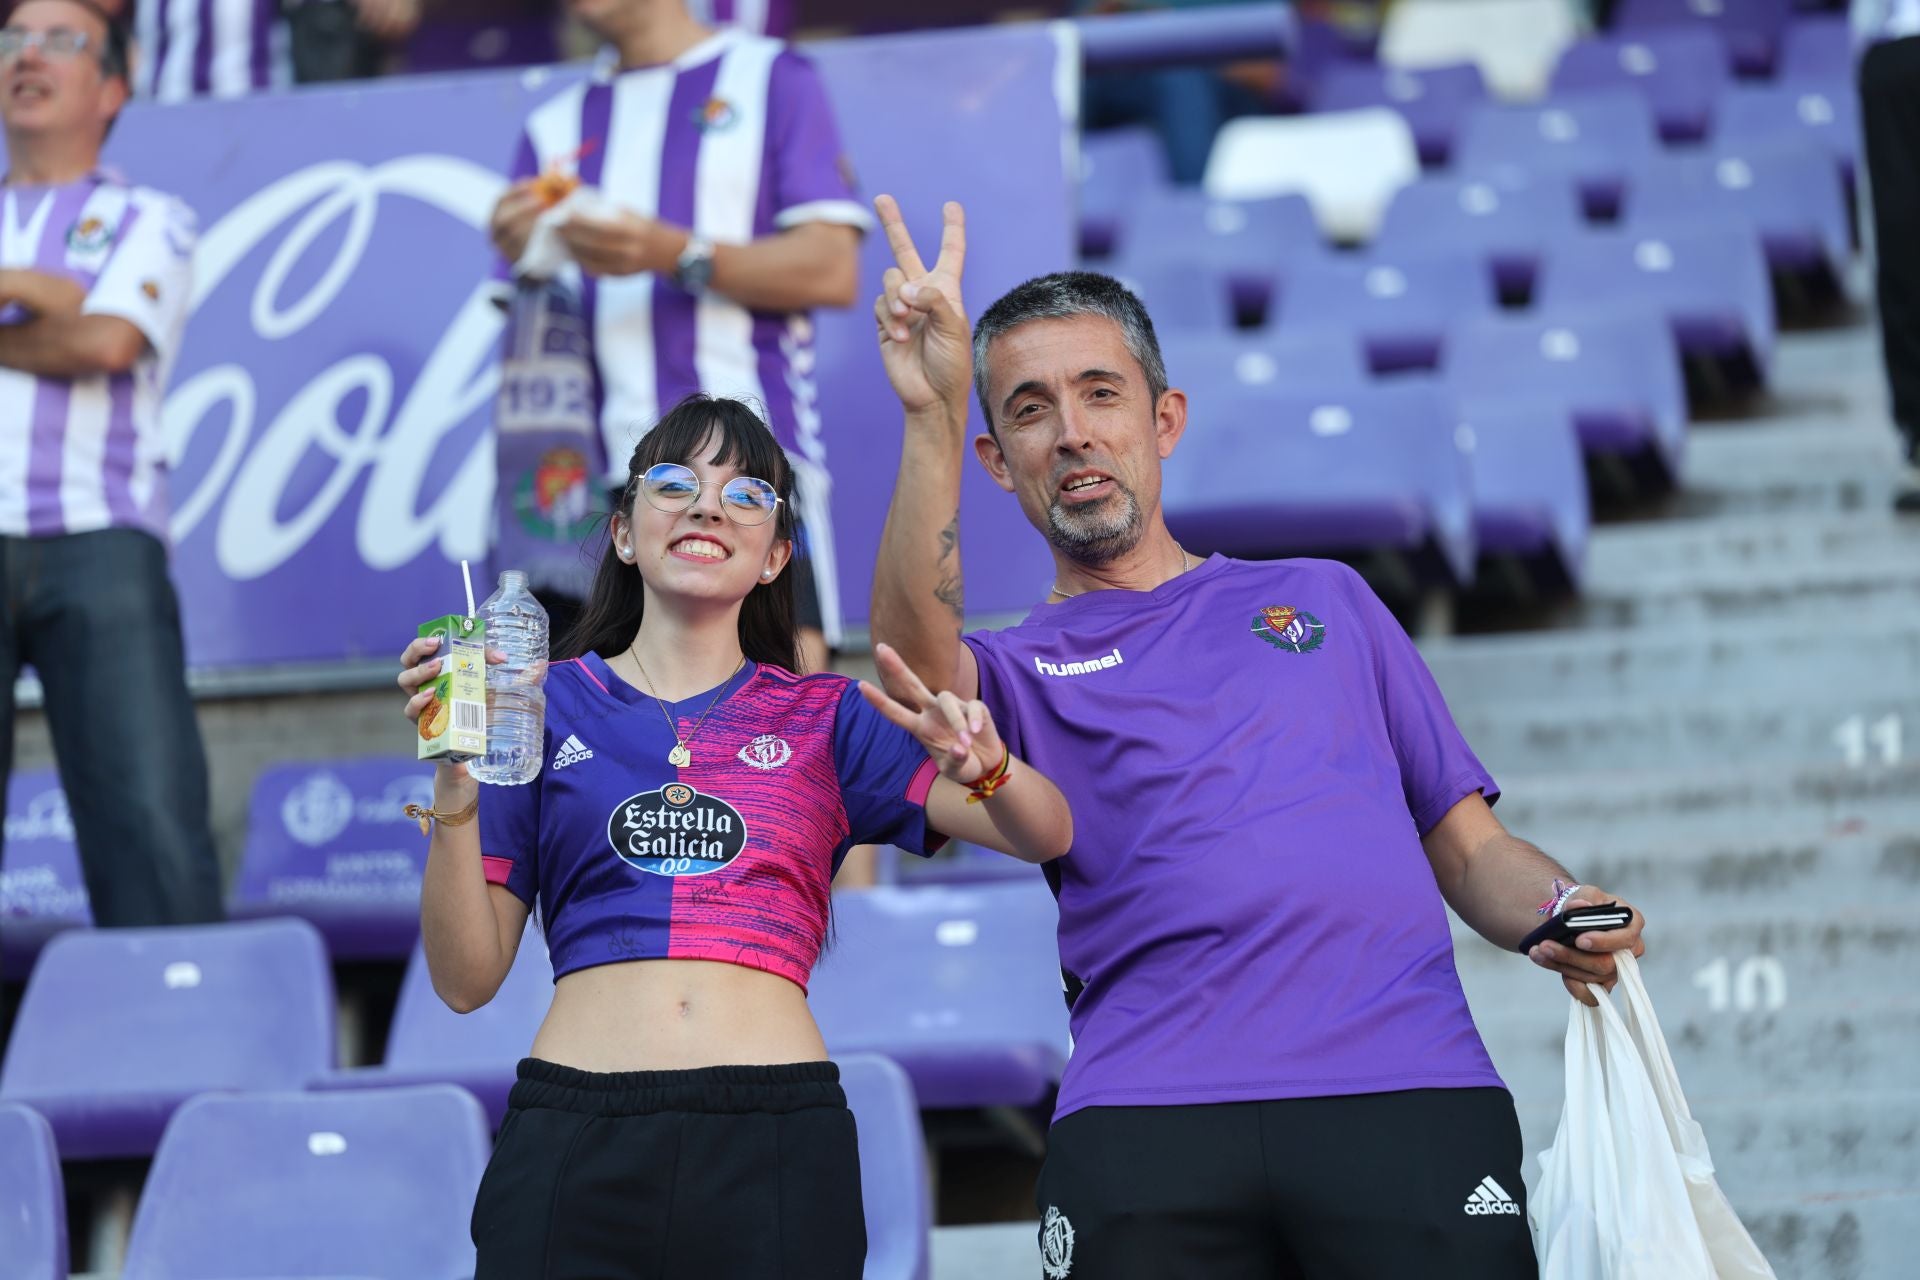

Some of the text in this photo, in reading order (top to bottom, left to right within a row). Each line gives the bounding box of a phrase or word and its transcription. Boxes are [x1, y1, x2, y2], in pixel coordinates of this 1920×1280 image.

[1034, 648, 1124, 677] hummel
[1834, 712, 1903, 768] 11
[552, 749, 594, 770] adidas
[622, 803, 733, 834] Estrella
[628, 829, 725, 860] Galicia
[1692, 954, 1788, 1013] 10
[1463, 1199, 1521, 1217] adidas
